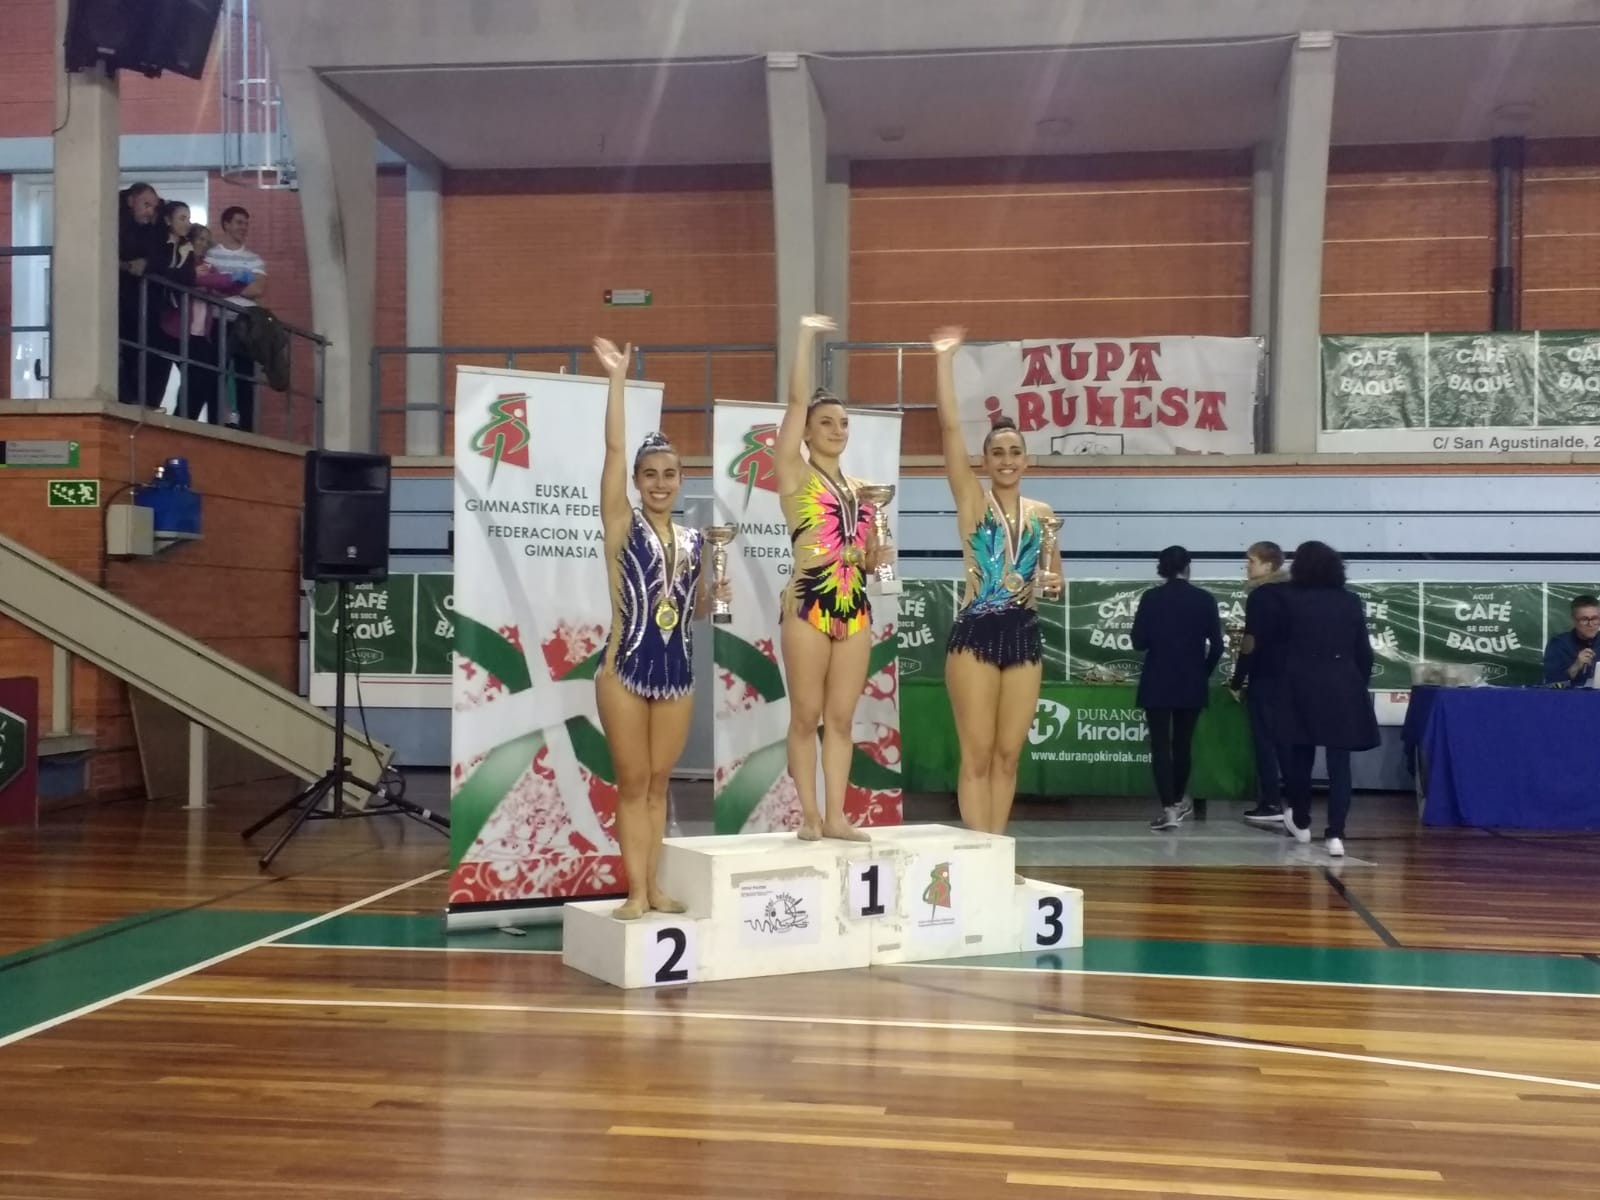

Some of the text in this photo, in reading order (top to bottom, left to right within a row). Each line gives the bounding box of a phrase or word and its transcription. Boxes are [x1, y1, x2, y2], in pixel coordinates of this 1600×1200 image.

[1021, 342, 1162, 387] AUPA
[1432, 436, 1449, 450] C/
[1453, 436, 1484, 449] San
[1489, 435, 1589, 452] Agustinalde,
[535, 483, 589, 500] EUSKAL
[464, 498, 561, 516] GIMNASTIKA
[487, 524, 579, 541] FEDERACION
[724, 521, 787, 536] IMNAST
[524, 543, 599, 560] GIMNASIA
[1454, 600, 1513, 623] CAFÉ
[1446, 628, 1521, 653] BAQUÉ
[1031, 750, 1153, 764] www.durangokirolak.net
[861, 865, 885, 916] 1
[1036, 896, 1064, 946] 3
[655, 927, 689, 983] 2
